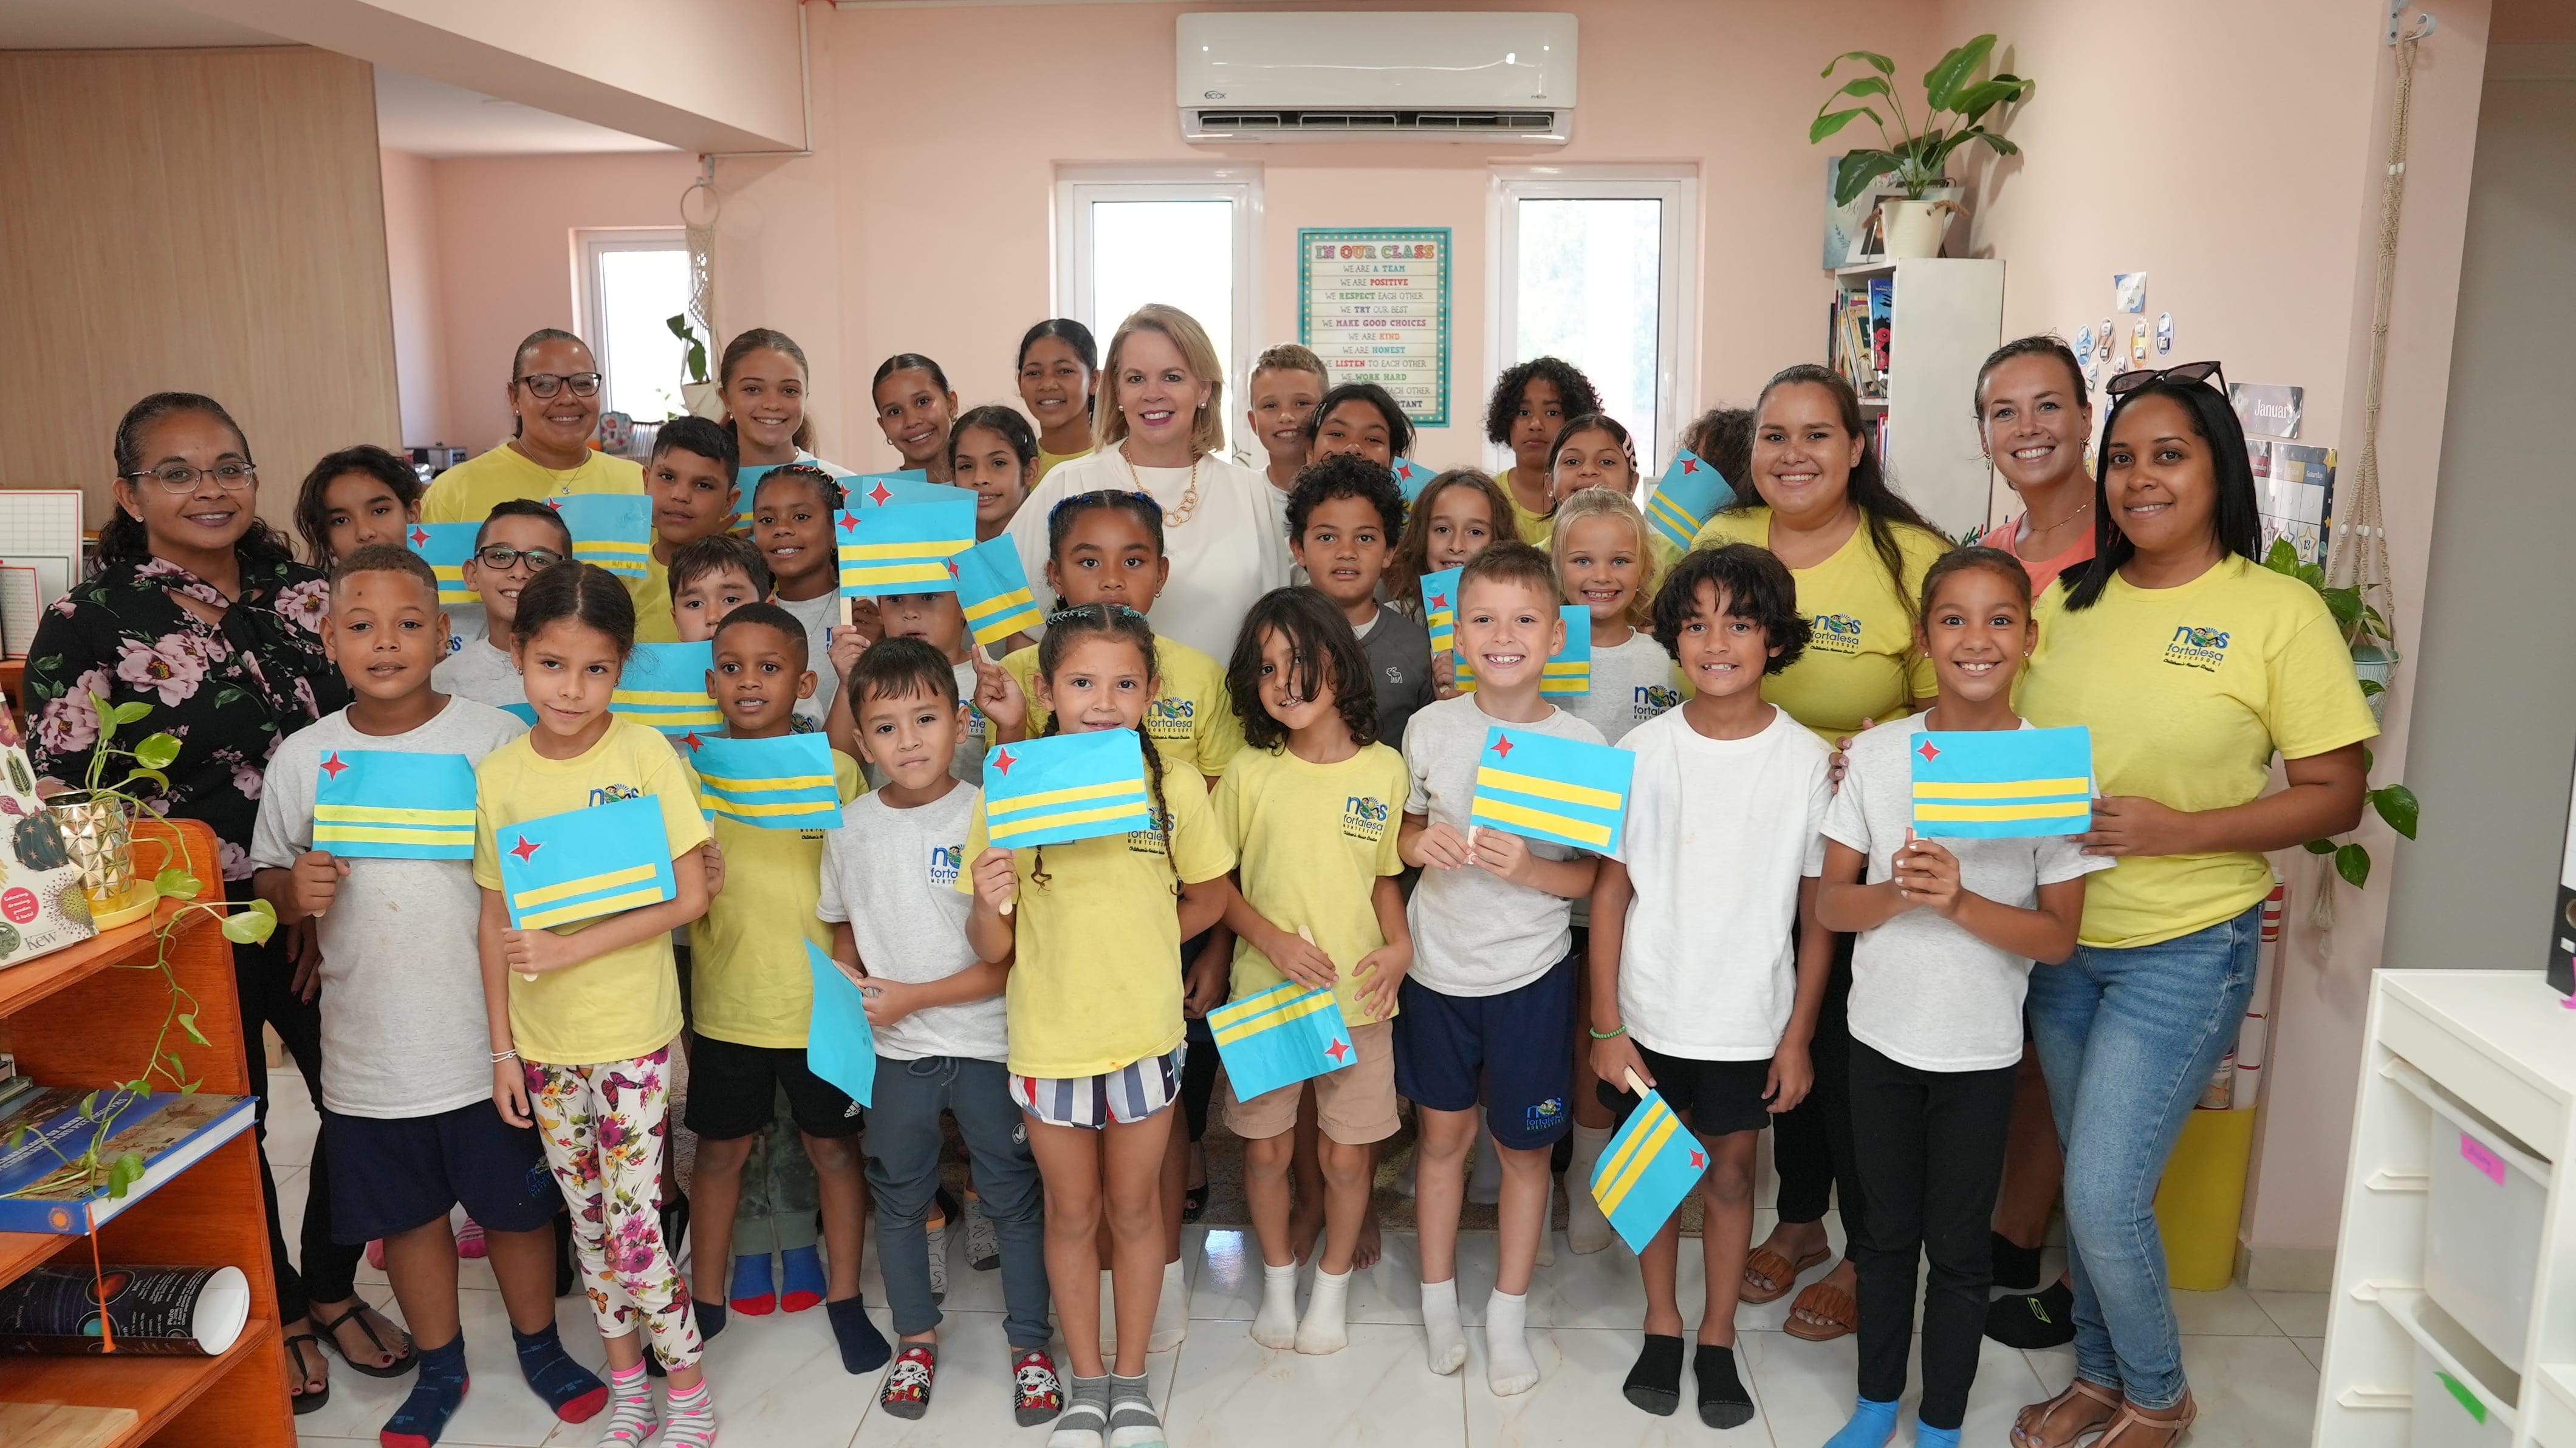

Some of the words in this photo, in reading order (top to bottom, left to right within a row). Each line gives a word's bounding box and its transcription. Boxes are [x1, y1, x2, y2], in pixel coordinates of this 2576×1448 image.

[1315, 245, 1335, 259] IN
[1340, 245, 1376, 259] OUR
[1381, 245, 1434, 259] CLASS
[2255, 399, 2293, 424] January
[2304, 539, 2311, 550] 13
[1811, 631, 1859, 645] fortalesa
[2167, 643, 2224, 661] fortalesa
[2164, 652, 2221, 667] MONTESSORI
[1634, 705, 1666, 715] fortale
[1147, 718, 1193, 728] fortalesa
[1343, 814, 1383, 831] fortalesa
[930, 867, 958, 878] forta
[24, 932, 57, 951] Kew
